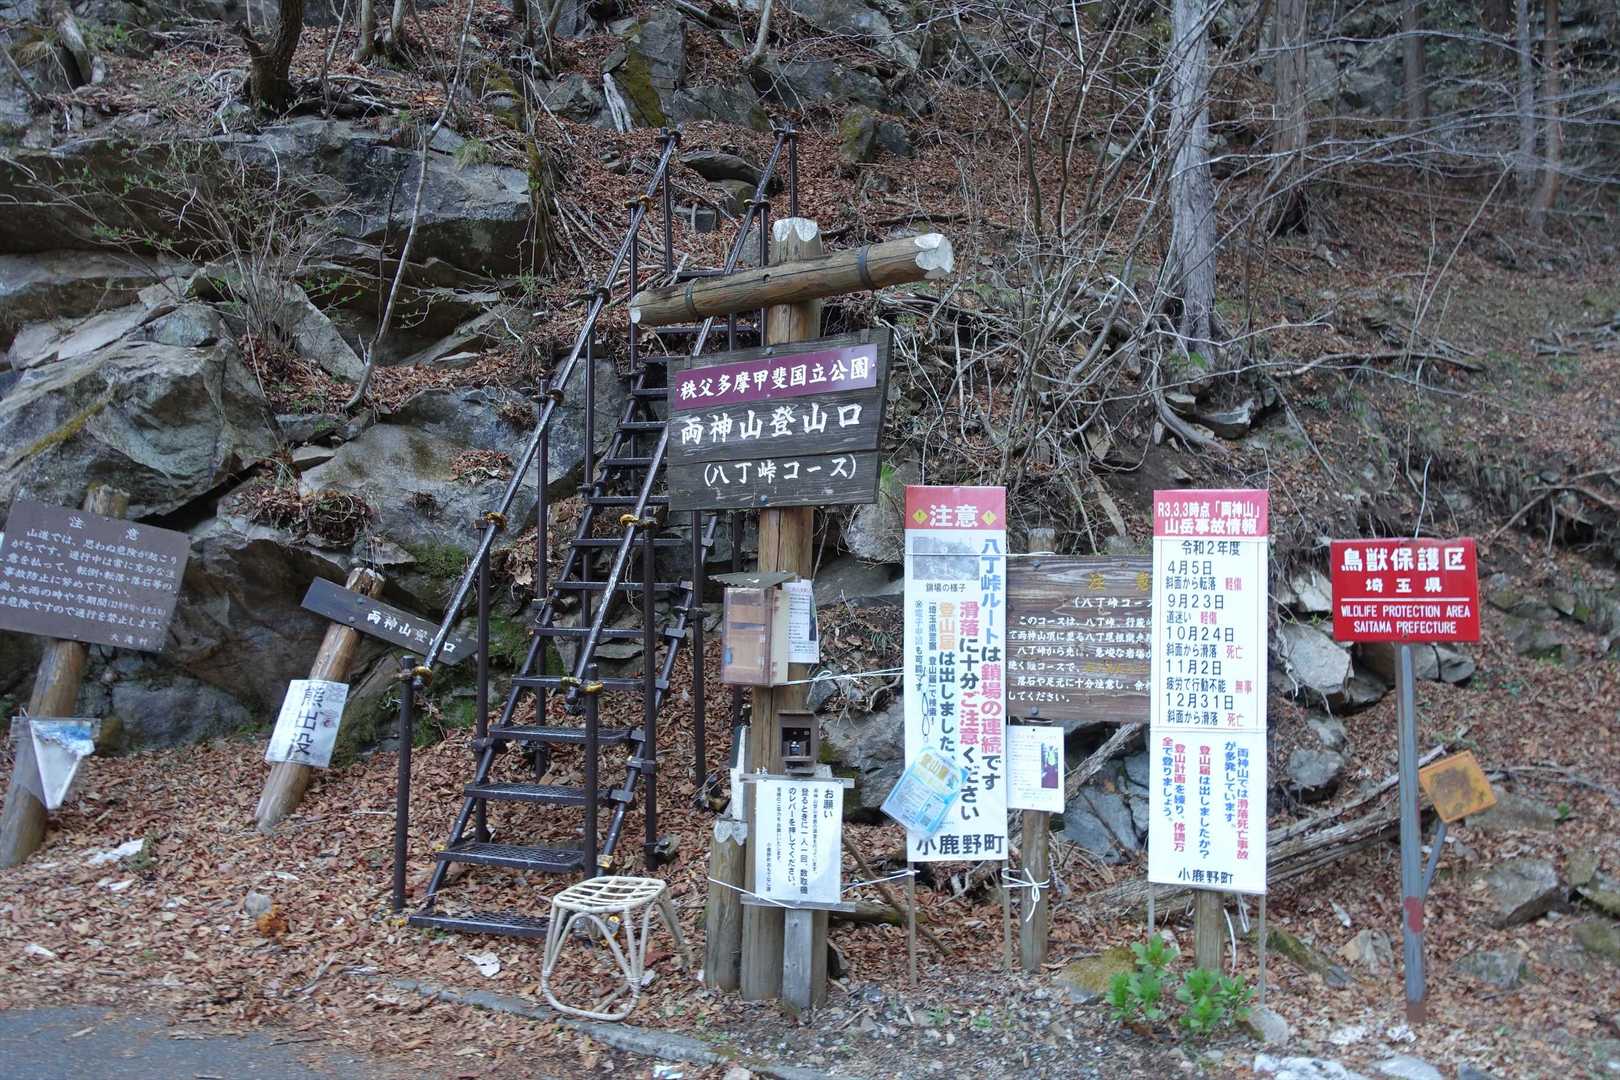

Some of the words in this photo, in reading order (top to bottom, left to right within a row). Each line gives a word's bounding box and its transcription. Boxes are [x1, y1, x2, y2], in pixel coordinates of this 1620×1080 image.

[680, 356, 869, 401] 秩父多摩甲斐国立公園
[681, 402, 863, 445] 両神山登山口
[704, 454, 857, 487] (八丁峠コース)
[929, 504, 979, 527] 注意
[1164, 518, 1257, 535] 山岳事故情報
[1181, 540, 1241, 556] 令和2年度
[1167, 561, 1212, 576] 4月5日
[1341, 547, 1466, 573] 鳥獣保護区
[1165, 576, 1217, 591] 斜面から転落
[1365, 577, 1443, 593] 埼玉県
[1167, 593, 1224, 609] 9月23日
[1167, 610, 1191, 624] 道迷い
[1341, 605, 1378, 617] WILDLIFE
[1383, 605, 1440, 617] PROTECTION
[1446, 605, 1471, 617] AREA
[1166, 626, 1233, 642] 10月24日
[1354, 620, 1392, 633] SAITAMA
[1396, 621, 1457, 634] PREFECTURE
[1166, 642, 1217, 658] 斜面から滑落
[1226, 644, 1243, 659] 死亡
[1166, 659, 1222, 675] 11月2日
[1166, 676, 1226, 693] 疲労で行動不能
[1166, 692, 1233, 710] 12月31日
[1167, 709, 1218, 725] 斜面から滑落
[1227, 712, 1244, 727] 死亡
[823, 789, 834, 818] お願い
[916, 834, 1005, 855] 小鹿野町
[1178, 867, 1234, 885] 小鹿野町
